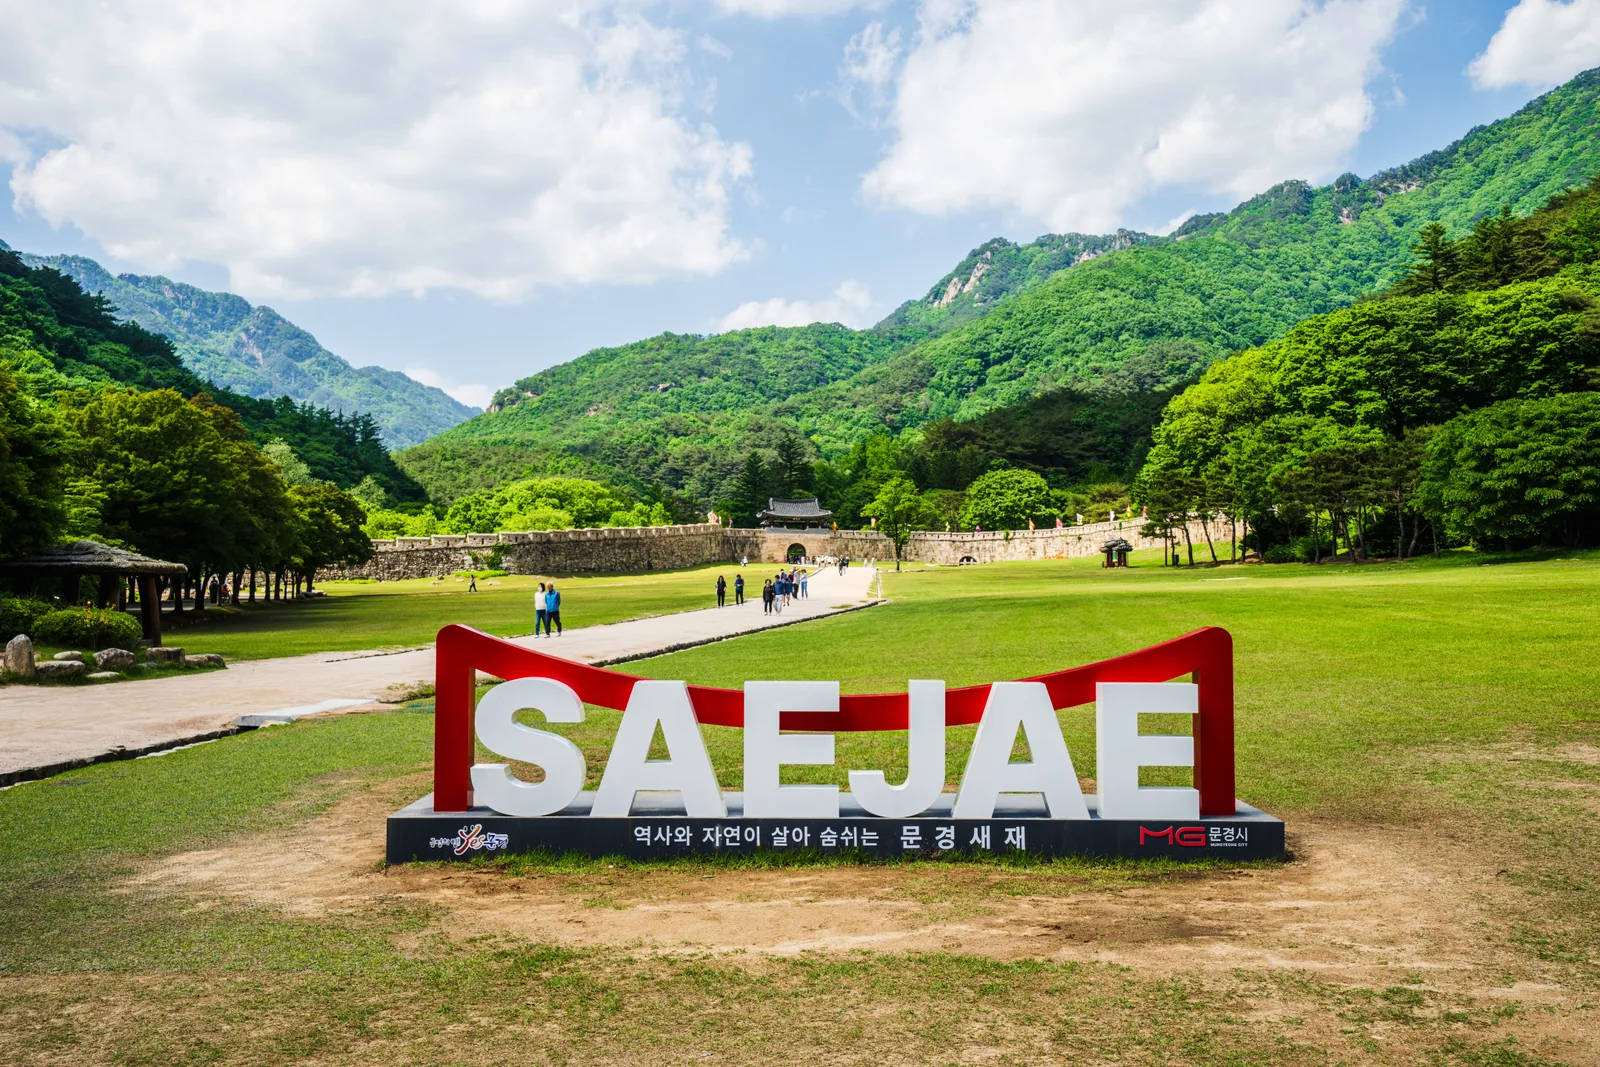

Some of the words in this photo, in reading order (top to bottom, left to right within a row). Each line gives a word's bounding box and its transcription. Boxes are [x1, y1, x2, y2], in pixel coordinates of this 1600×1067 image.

[471, 676, 1200, 820] SAEJAE
[454, 823, 486, 856] Yes
[633, 825, 693, 846] 역사와
[702, 825, 761, 847] 자연이
[771, 826, 811, 847] 살아
[819, 826, 880, 847] 숨쉬는
[1139, 825, 1207, 847] MG
[1208, 827, 1249, 842] 문경시
